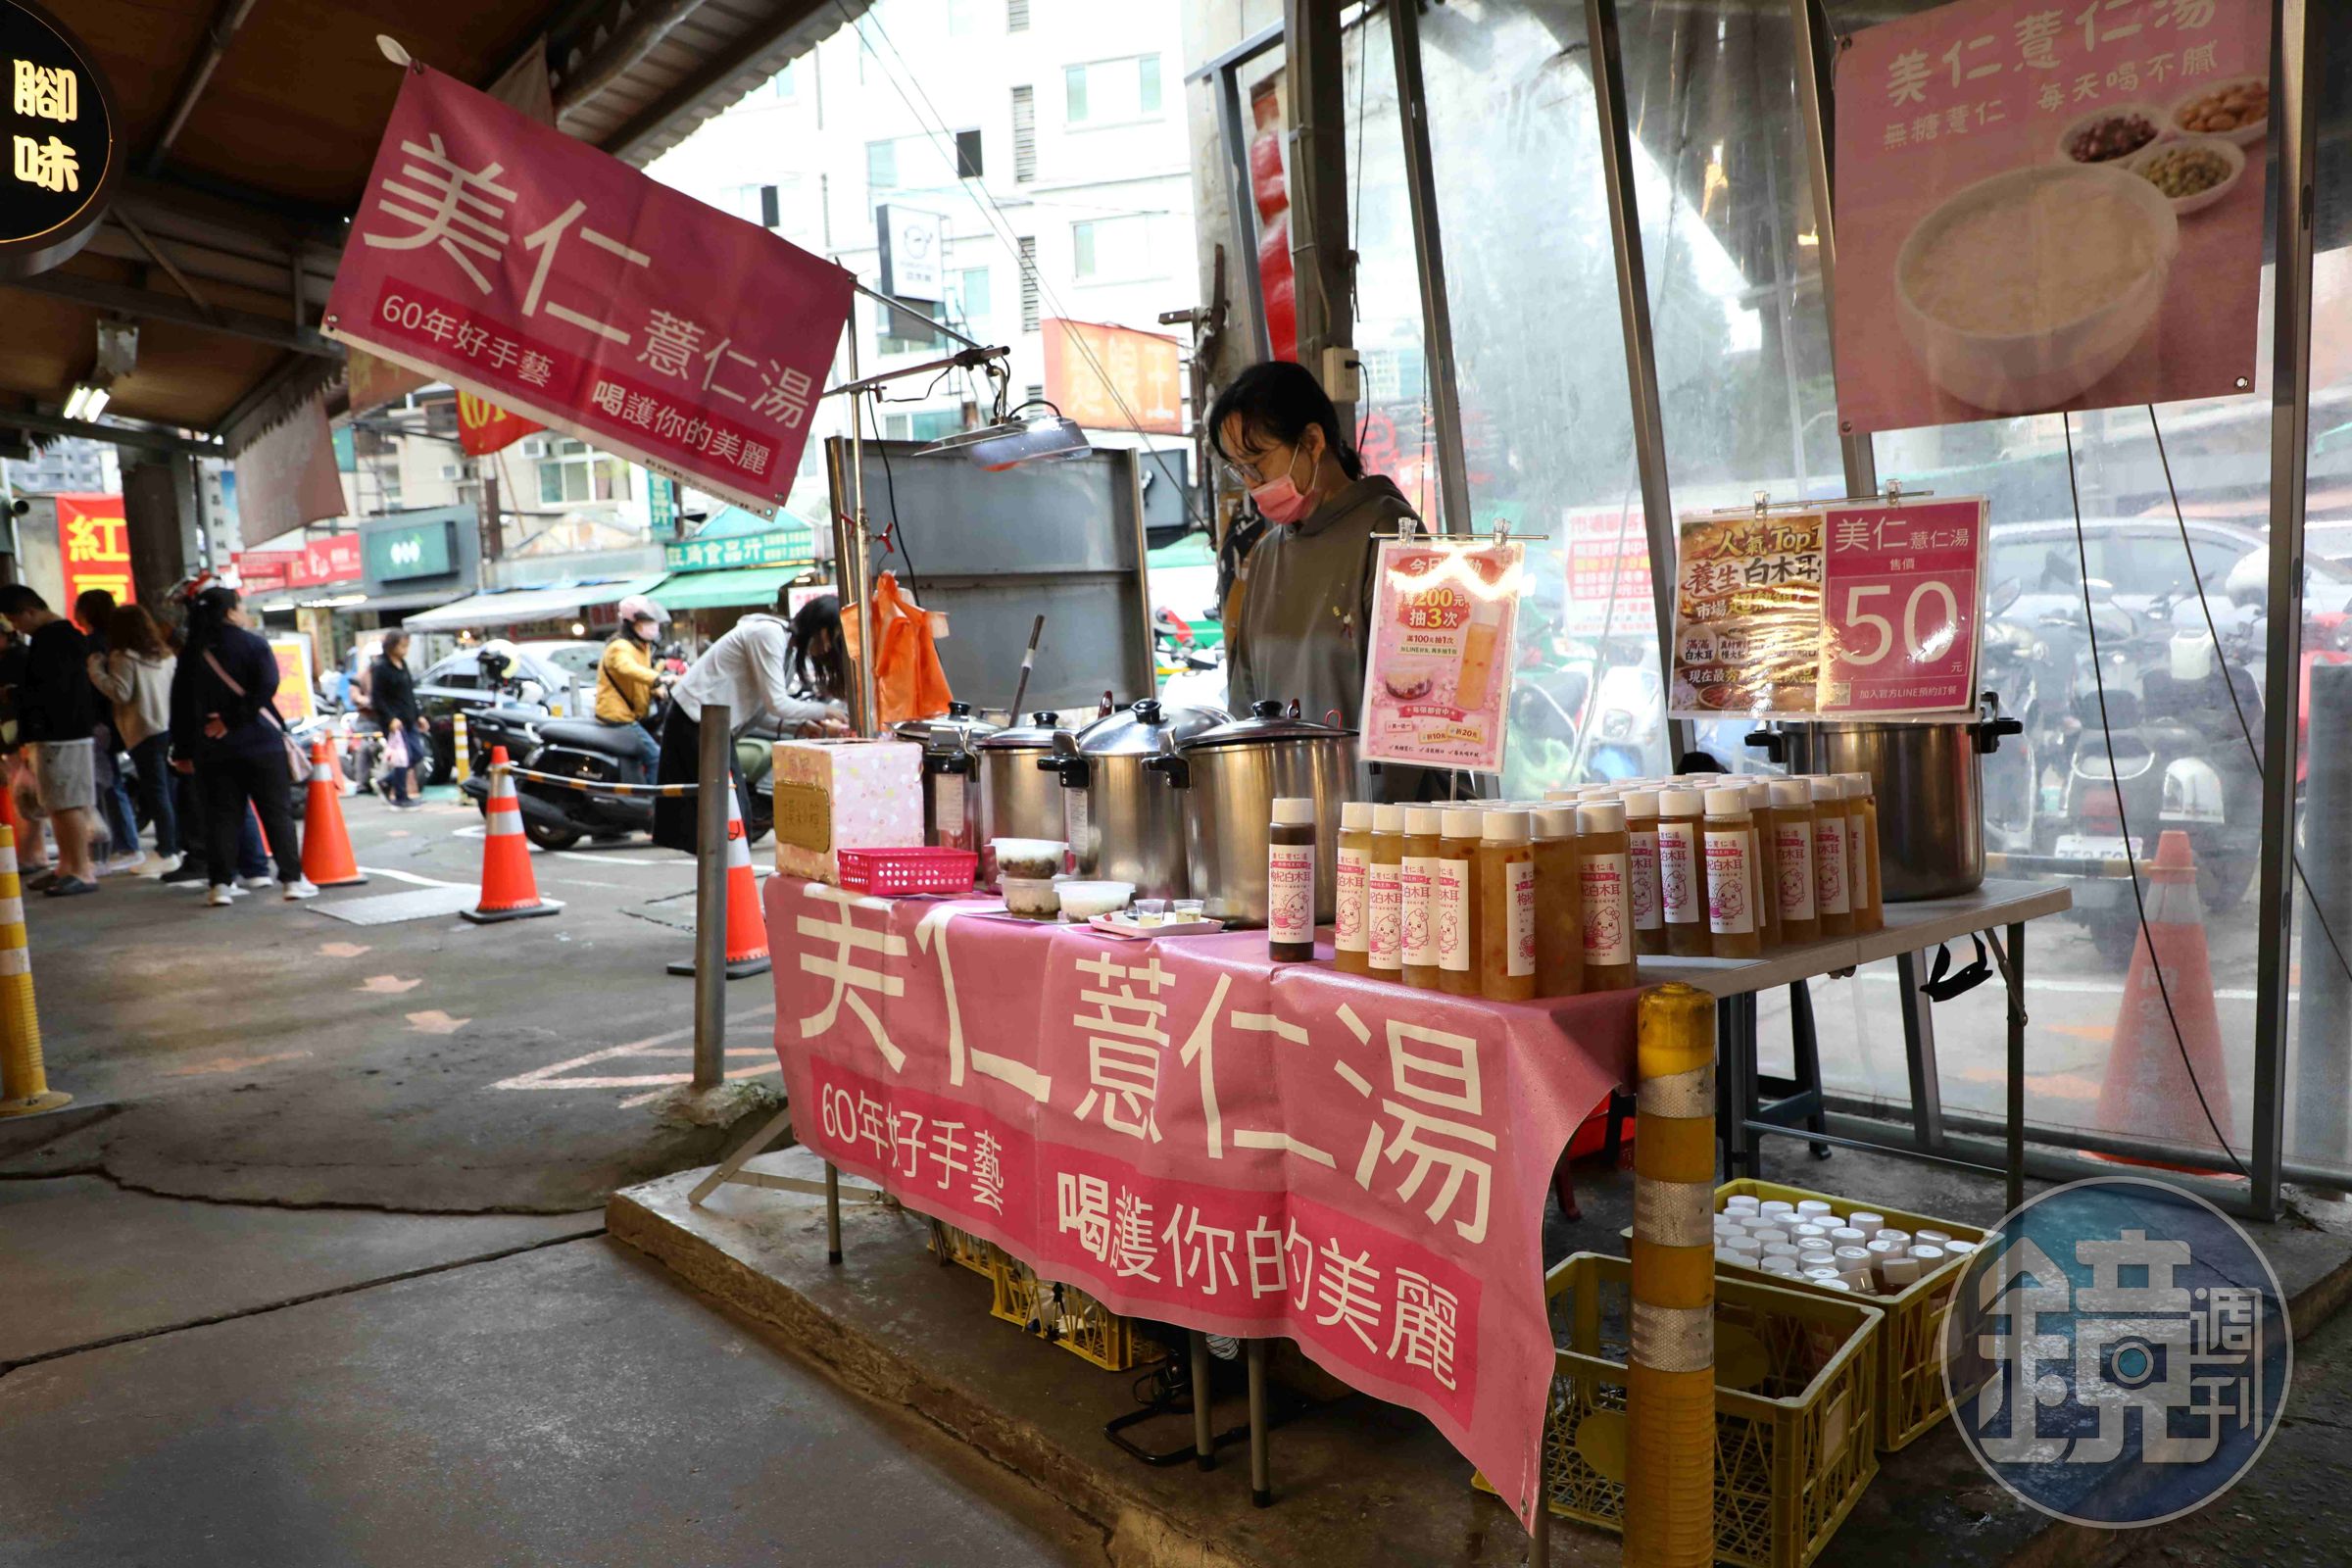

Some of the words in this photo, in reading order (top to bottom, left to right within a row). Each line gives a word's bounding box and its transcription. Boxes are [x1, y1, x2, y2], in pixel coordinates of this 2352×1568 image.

[1884, 99, 2006, 151] 無糖薏仁
[2037, 39, 2218, 112] 每天喝不膩
[363, 133, 812, 430] 美仁薏仁湯
[381, 294, 556, 388] 60年好手藝
[591, 380, 771, 476] 喝護你的美麗
[1835, 516, 1970, 553] 美仁薏仁湯
[1686, 554, 1822, 594] 養生白木耳
[1889, 558, 1915, 571] 售價
[1409, 608, 1459, 629] 抽3次
[1839, 580, 1958, 665] 50
[1950, 662, 1962, 672] 元
[1338, 876, 1365, 888] 白木耳
[820, 1082, 1005, 1217] 60年好手藝
[1056, 1170, 1459, 1393] 喝護你的美麗
